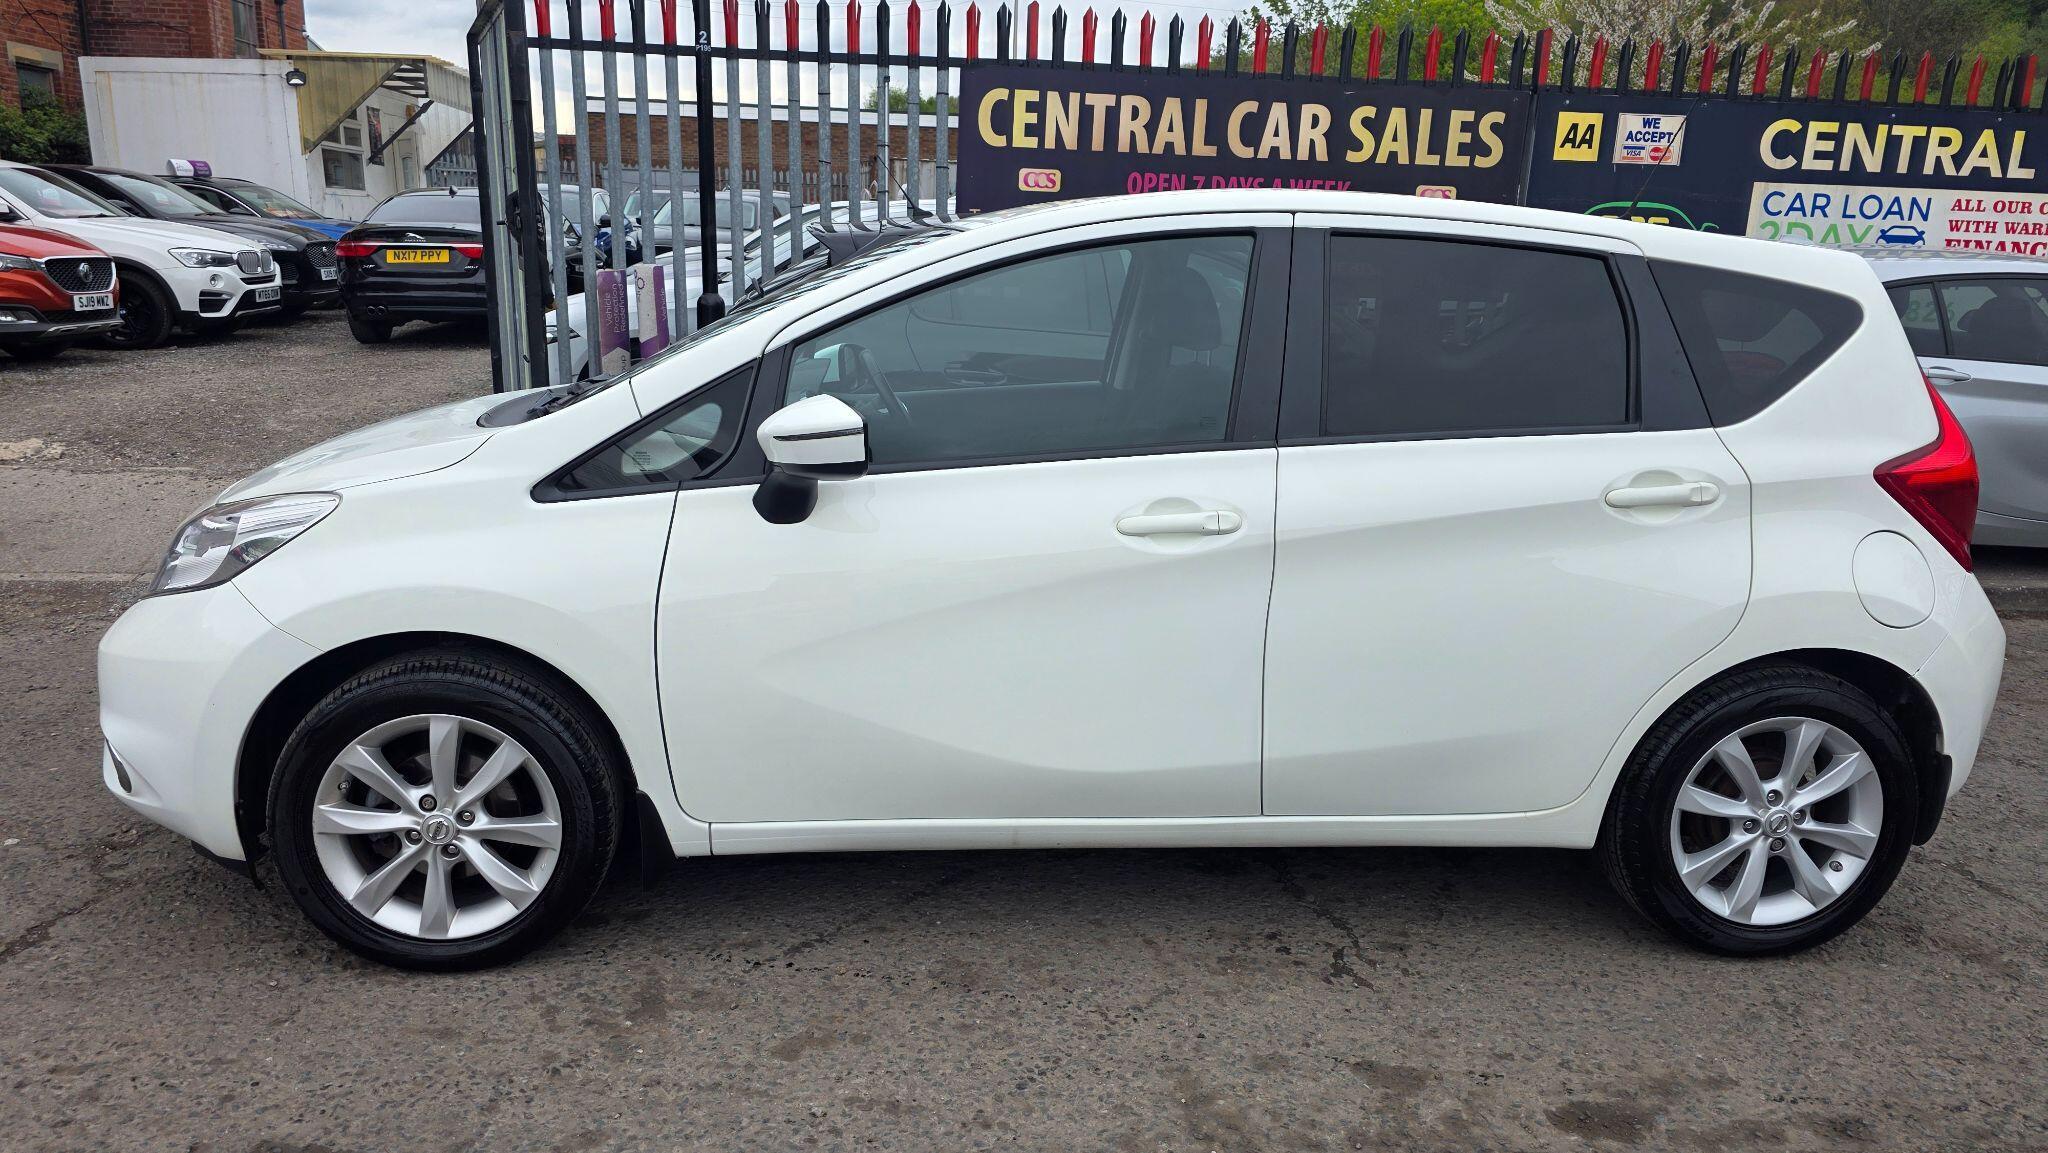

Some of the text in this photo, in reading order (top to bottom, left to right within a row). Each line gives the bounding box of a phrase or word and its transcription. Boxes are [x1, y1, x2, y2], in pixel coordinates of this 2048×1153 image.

[699, 30, 708, 44] 2
[977, 87, 1507, 169] CENTRAL CAR SALES
[1642, 117, 1662, 130] WE
[1559, 122, 1596, 150] AA
[1625, 130, 1674, 144] ACCEPT
[1626, 149, 1642, 157] VISA
[1759, 118, 2036, 180] CENTRAL
[1127, 171, 1187, 195] OPEN
[1762, 190, 1933, 222] CAR LOAN
[1950, 198, 1987, 213] ALL
[1992, 200, 2033, 215] OUR
[1948, 219, 1999, 235] WITH
[393, 250, 442, 261] NX17 PPY
[78, 295, 95, 308] SJ19
[603, 292, 613, 326] Vehicle
[612, 283, 620, 333] Protection
[619, 283, 627, 332] Redefined
